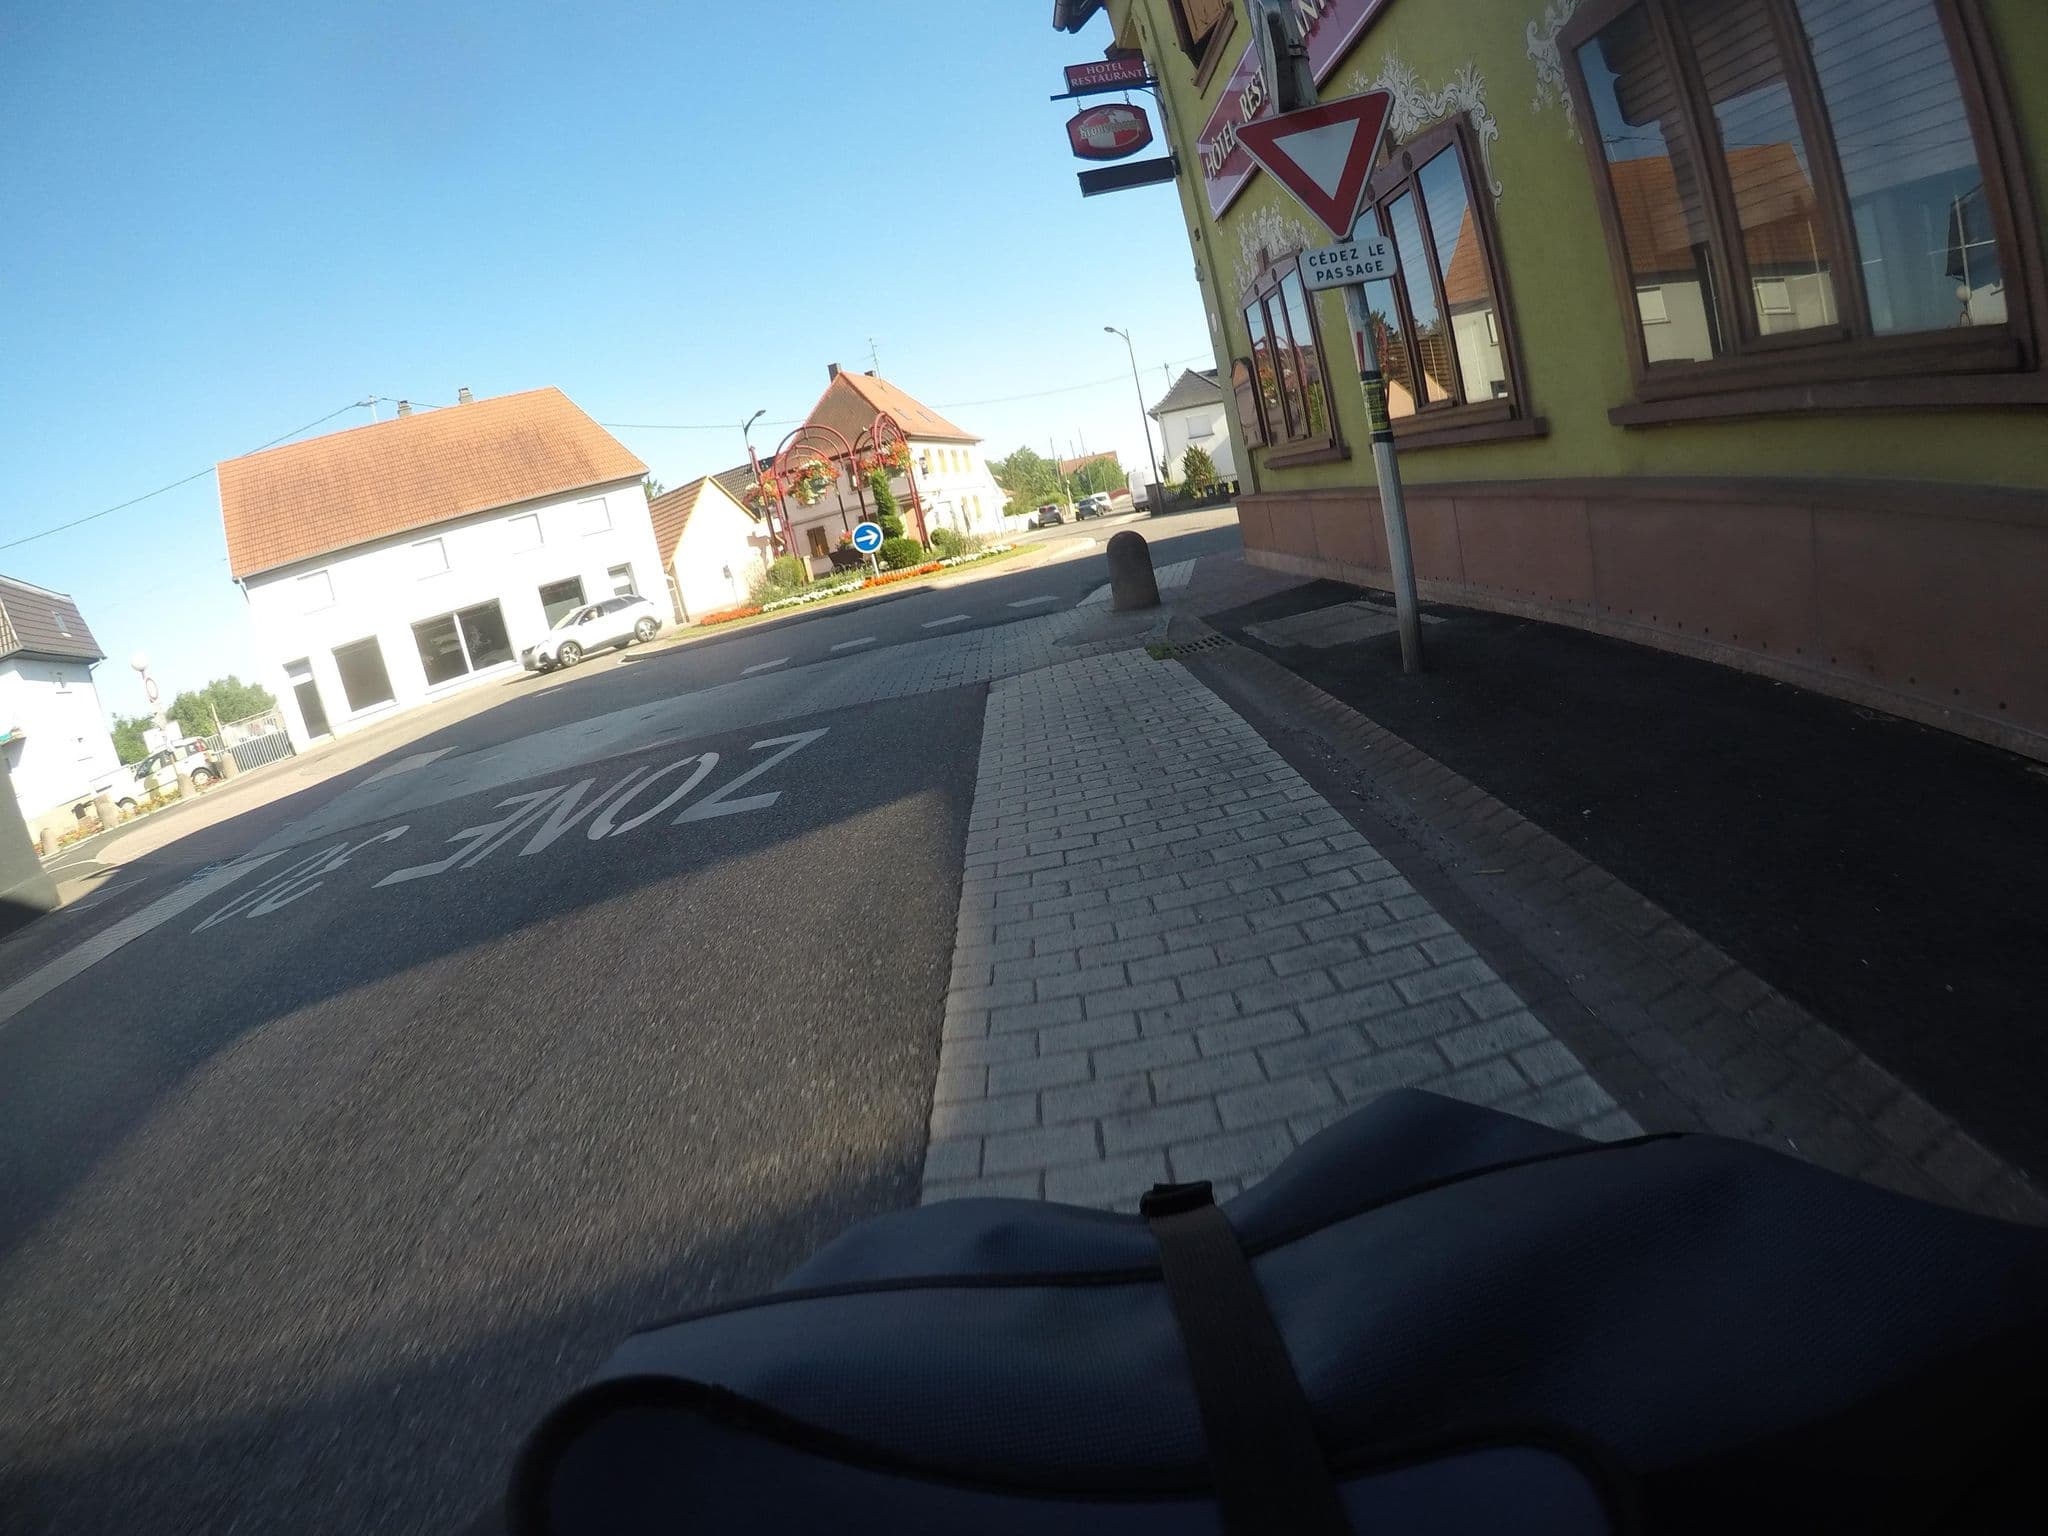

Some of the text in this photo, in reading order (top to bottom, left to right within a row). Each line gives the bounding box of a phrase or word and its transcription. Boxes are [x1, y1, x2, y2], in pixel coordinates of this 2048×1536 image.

[1071, 69, 1143, 87] RESTAURANT
[1087, 62, 1123, 75] HOTEL
[1309, 243, 1385, 267] CÉDEZ LE
[1316, 260, 1384, 282] PASSAGE
[190, 727, 830, 935] ZONE 30
